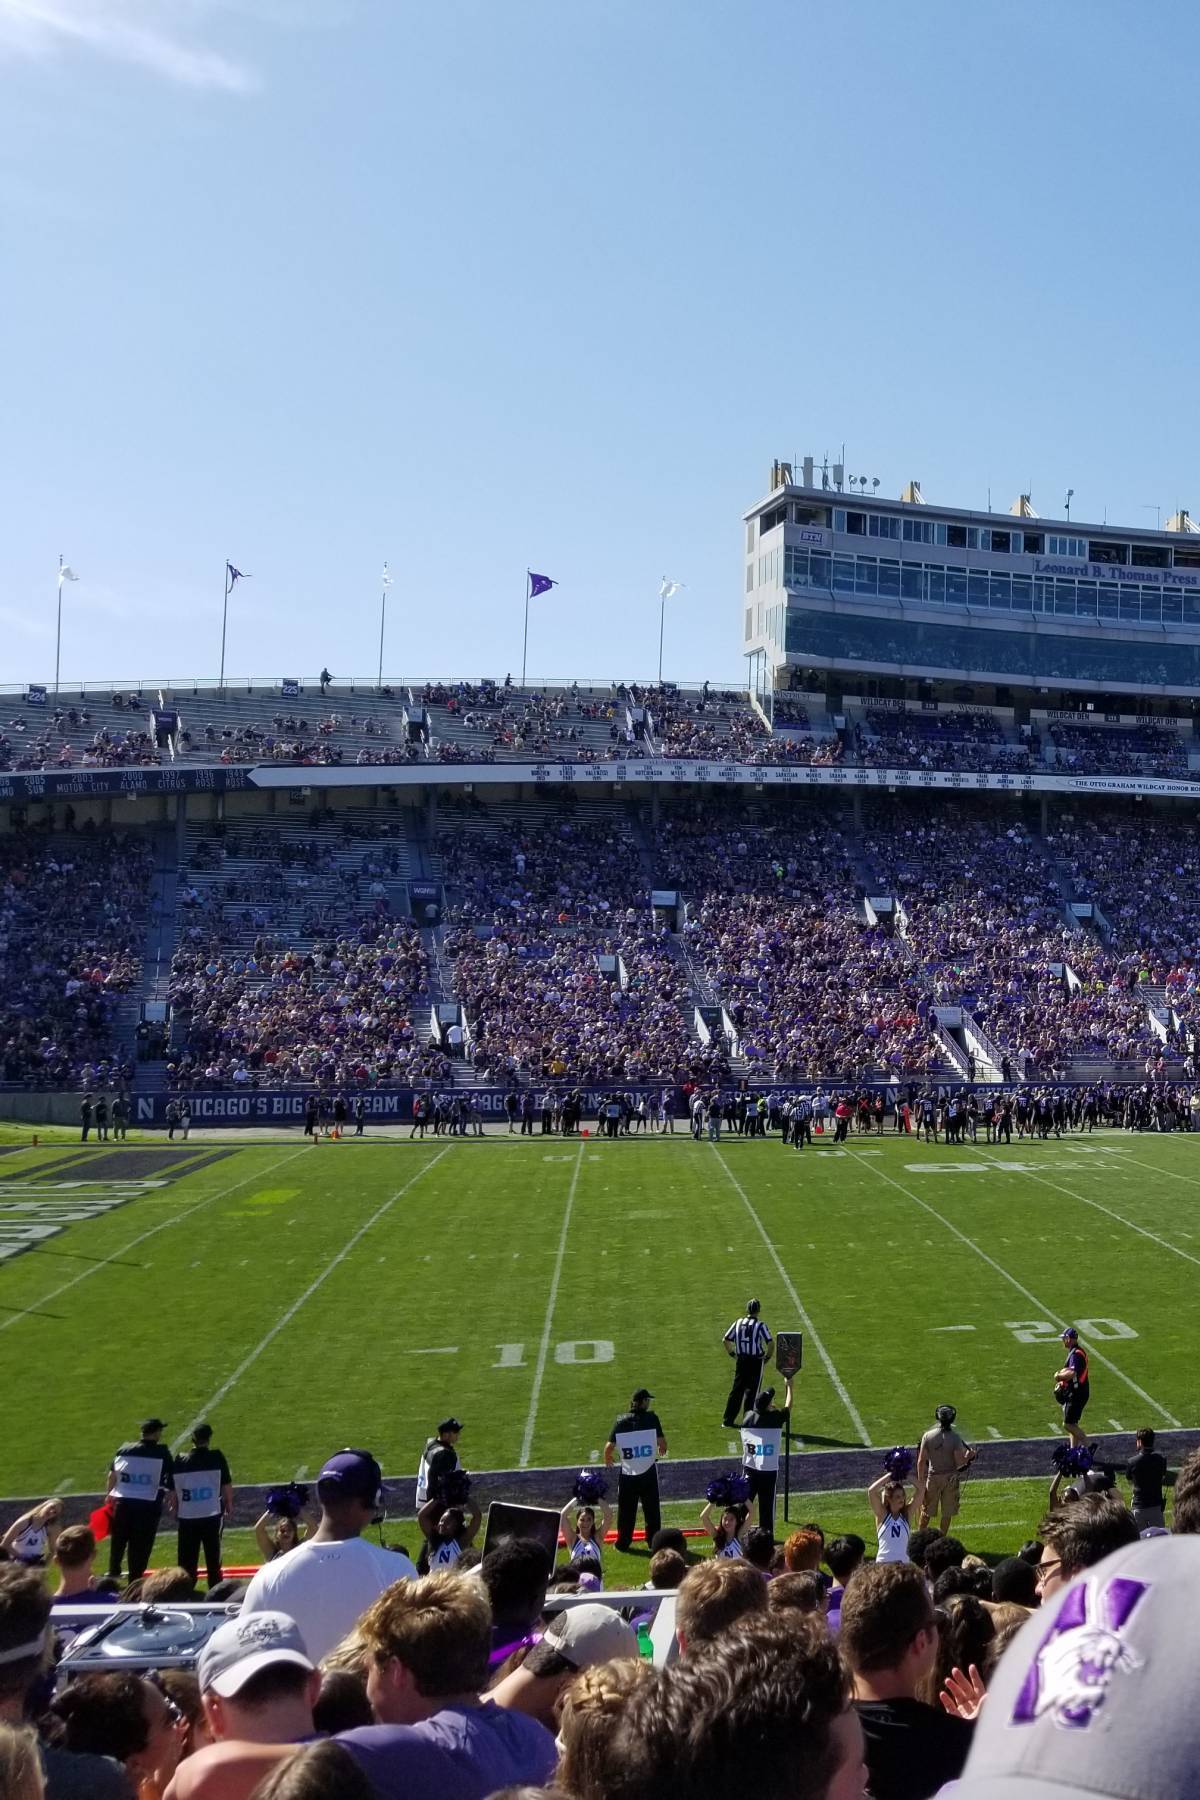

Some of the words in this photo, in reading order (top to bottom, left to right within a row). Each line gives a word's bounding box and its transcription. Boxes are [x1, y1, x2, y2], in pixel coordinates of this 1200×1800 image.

[1035, 559, 1089, 577] Leonard
[1093, 565, 1106, 578] B.
[1109, 567, 1159, 583] Thomas
[1163, 571, 1198, 586] Press
[860, 697, 891, 706] WILDCAT
[1046, 710, 1075, 720] WILDCAT
[1076, 712, 1090, 721] DEN
[1136, 716, 1164, 726] WILDCAT
[1165, 718, 1178, 727] DEN
[72, 774, 94, 783] 2003
[195, 778, 215, 788] ROSE
[225, 778, 245, 788] ROSE
[28, 785, 44, 794] SUN
[56, 783, 84, 793] MOTOR
[91, 782, 110, 792] CITY
[120, 780, 147, 790] ALAMO
[158, 780, 186, 789] CITRUS
[138, 1098, 153, 1119] N
[272, 1097, 303, 1115] BIG
[349, 1096, 399, 1113] TEAM
[741, 1325, 750, 1342] L
[1003, 1318, 1139, 1343] 20
[491, 1340, 614, 1368] 10
[621, 1445, 653, 1460] B1G
[745, 1443, 774, 1457] B1G
[891, 1525, 901, 1539] N
[439, 1549, 451, 1564] N
